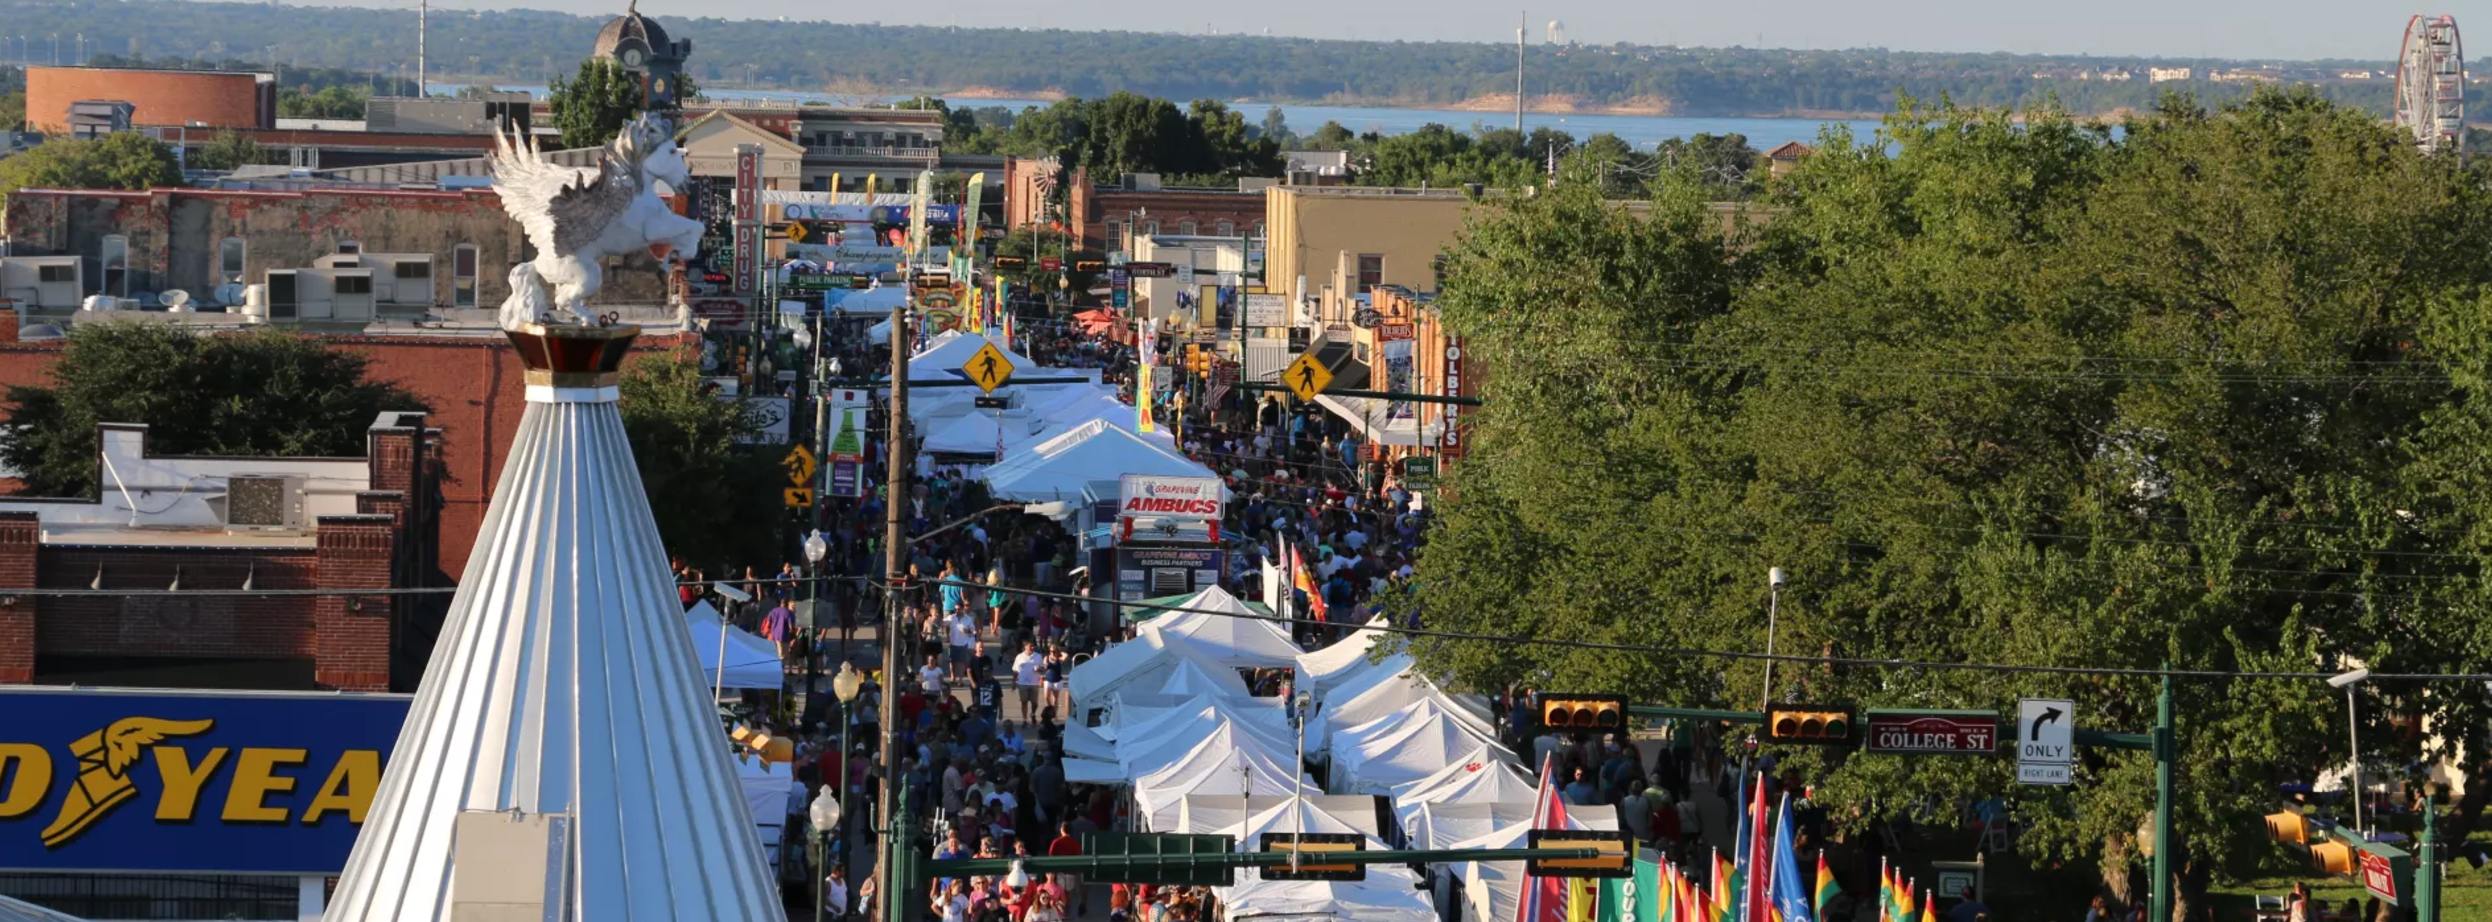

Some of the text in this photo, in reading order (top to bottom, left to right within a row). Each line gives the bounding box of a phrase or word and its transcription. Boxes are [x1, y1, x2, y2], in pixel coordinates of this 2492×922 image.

[739, 156, 751, 290] CITY DRUG
[1155, 485, 1200, 495] GRAPEVINE
[1126, 497, 1219, 514] AMBUCS
[979, 691, 992, 706] 12
[1879, 733, 1988, 749] COLLEGE ST
[2025, 745, 2064, 757] ONLY
[2024, 769, 2064, 779] RIGHT LANE
